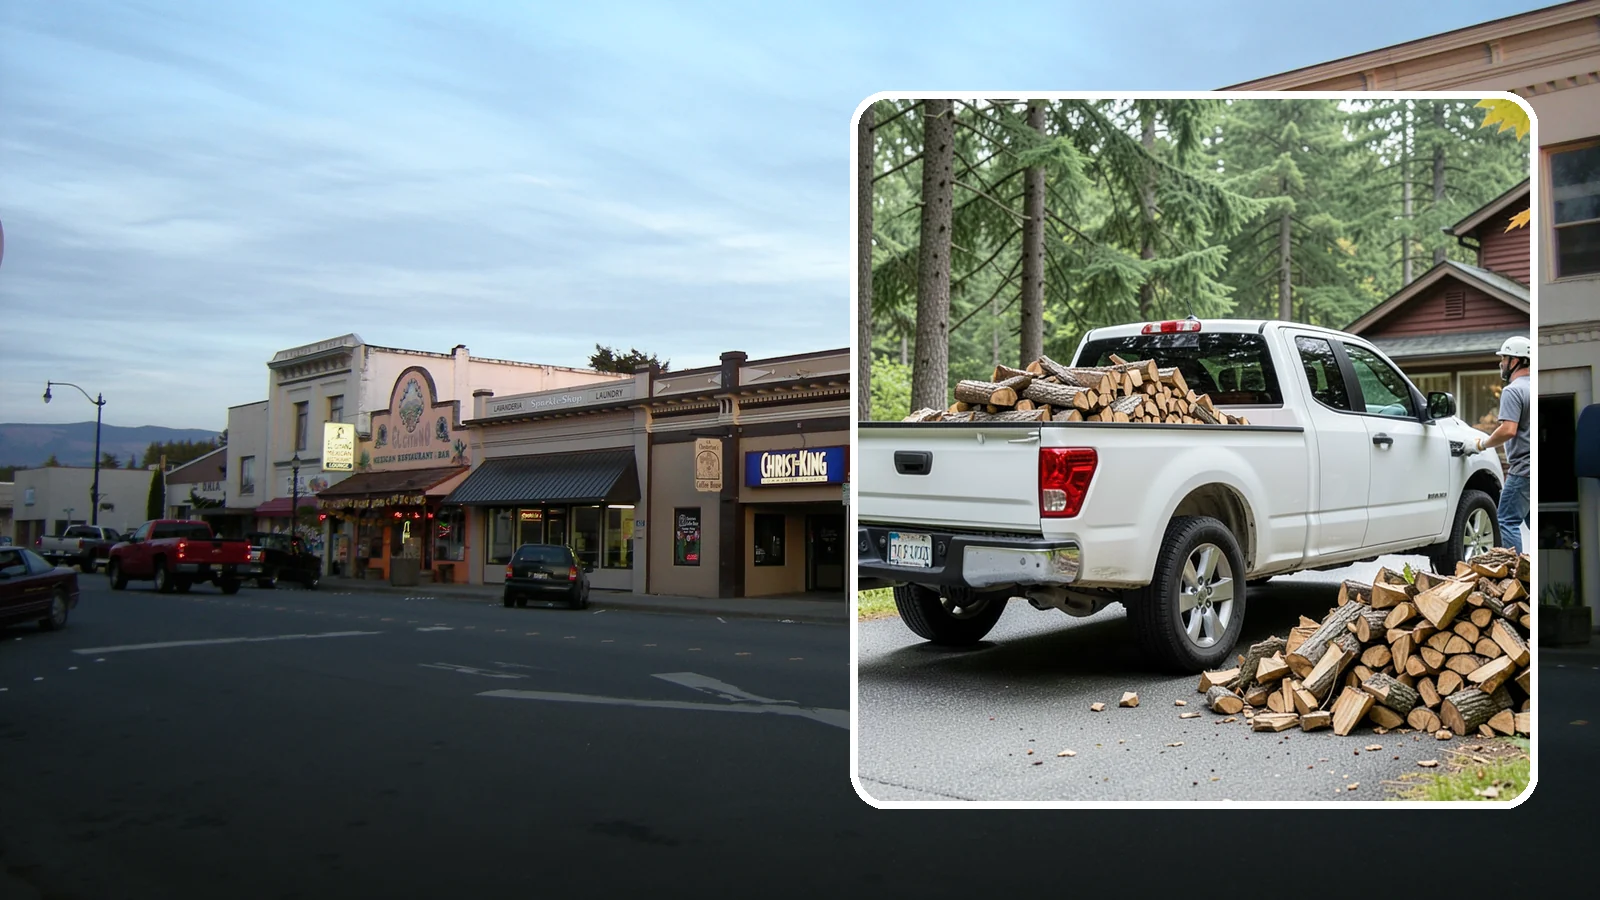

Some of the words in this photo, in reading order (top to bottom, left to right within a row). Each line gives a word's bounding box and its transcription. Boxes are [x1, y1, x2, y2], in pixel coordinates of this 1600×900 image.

[596, 389, 623, 399] LAUNDRY
[494, 402, 522, 412] LAVANDERIA
[398, 452, 433, 462] RESTAURANT
[438, 451, 450, 459] BAR
[761, 452, 797, 477] CHRIST
[799, 450, 826, 476] KING
